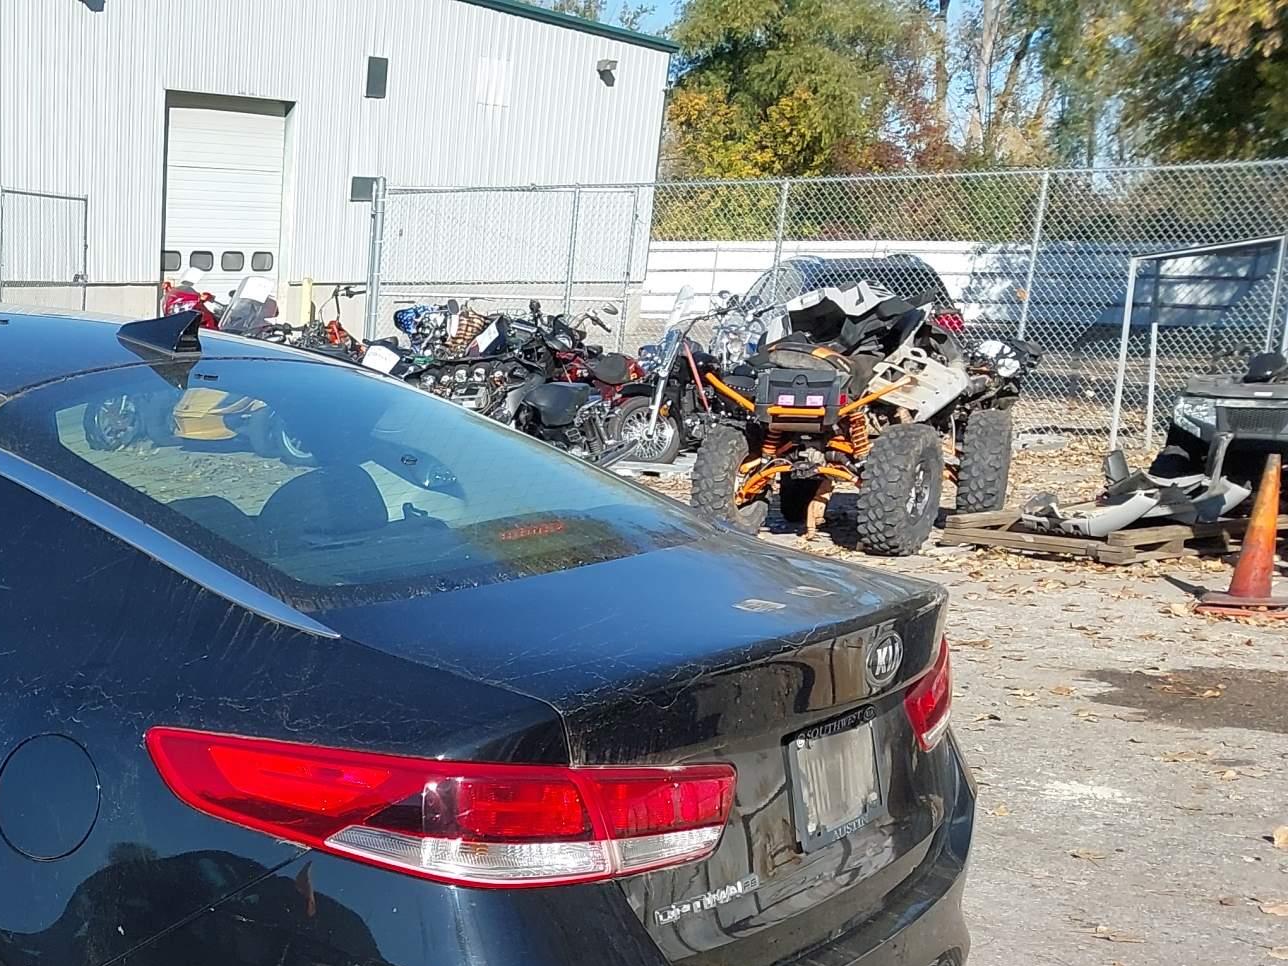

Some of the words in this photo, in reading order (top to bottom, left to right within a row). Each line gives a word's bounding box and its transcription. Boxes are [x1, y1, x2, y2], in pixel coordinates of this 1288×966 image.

[875, 640, 900, 676] KIA
[806, 711, 863, 739] SOUTHWEST
[832, 814, 868, 841] AUSTIN
